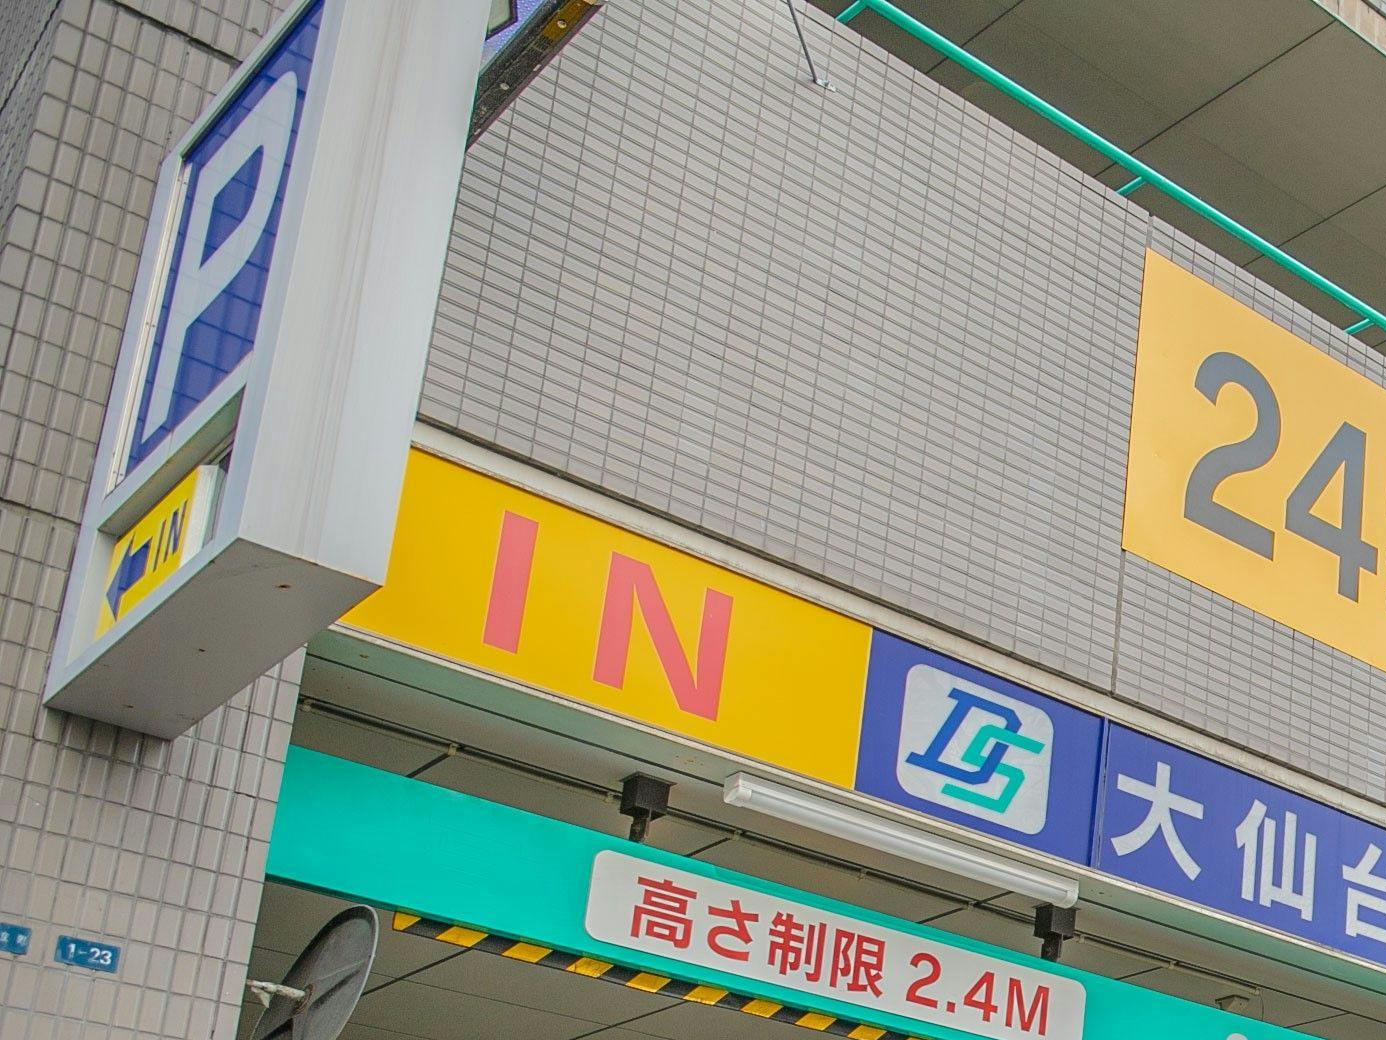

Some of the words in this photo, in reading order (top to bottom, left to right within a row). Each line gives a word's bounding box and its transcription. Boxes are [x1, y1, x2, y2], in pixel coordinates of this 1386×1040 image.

[140, 71, 298, 445] P
[152, 498, 189, 573] IN
[1183, 351, 1378, 603] 24
[482, 510, 734, 722] IN
[67, 943, 112, 965] 1-23
[630, 876, 887, 998] 高さ制限
[905, 952, 1050, 1037] 2.4M
